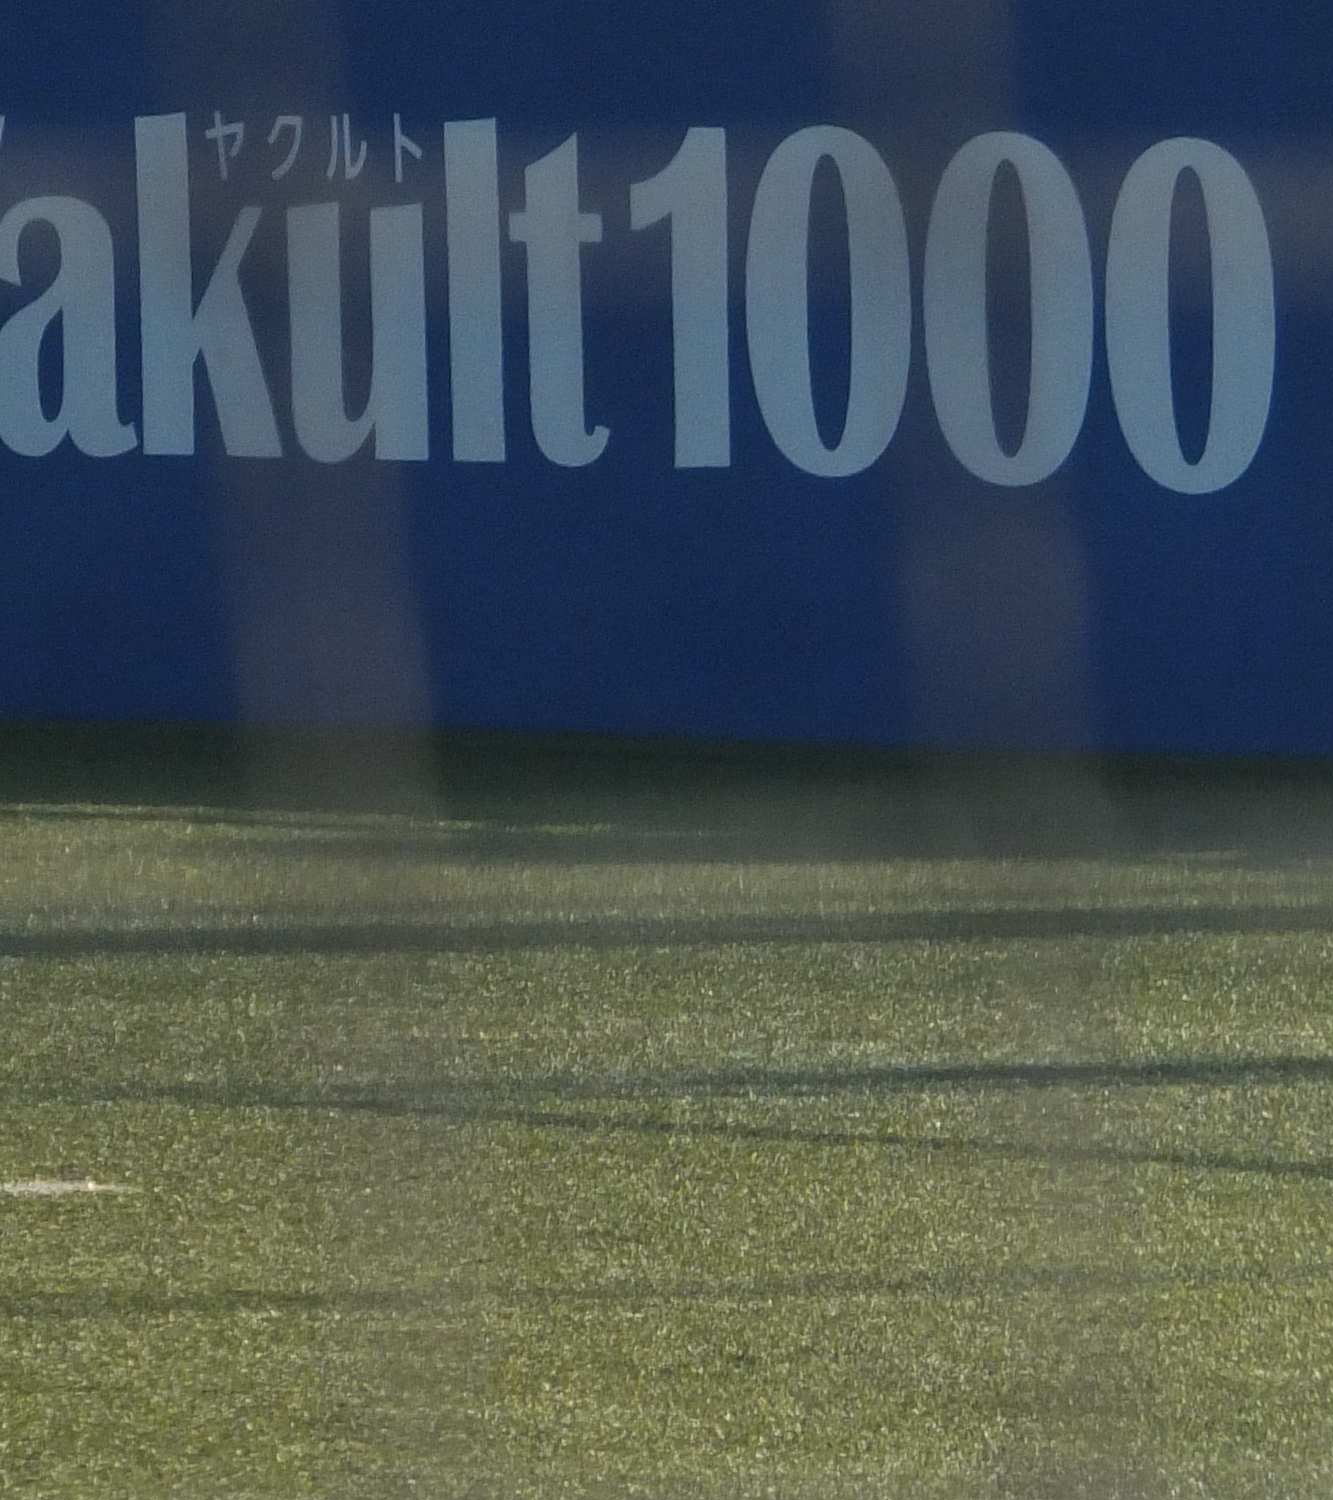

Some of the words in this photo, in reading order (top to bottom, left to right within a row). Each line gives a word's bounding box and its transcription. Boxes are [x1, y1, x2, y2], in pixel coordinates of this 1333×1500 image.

[204, 109, 423, 183] ヤクルト
[0, 111, 1276, 495] akult1000
